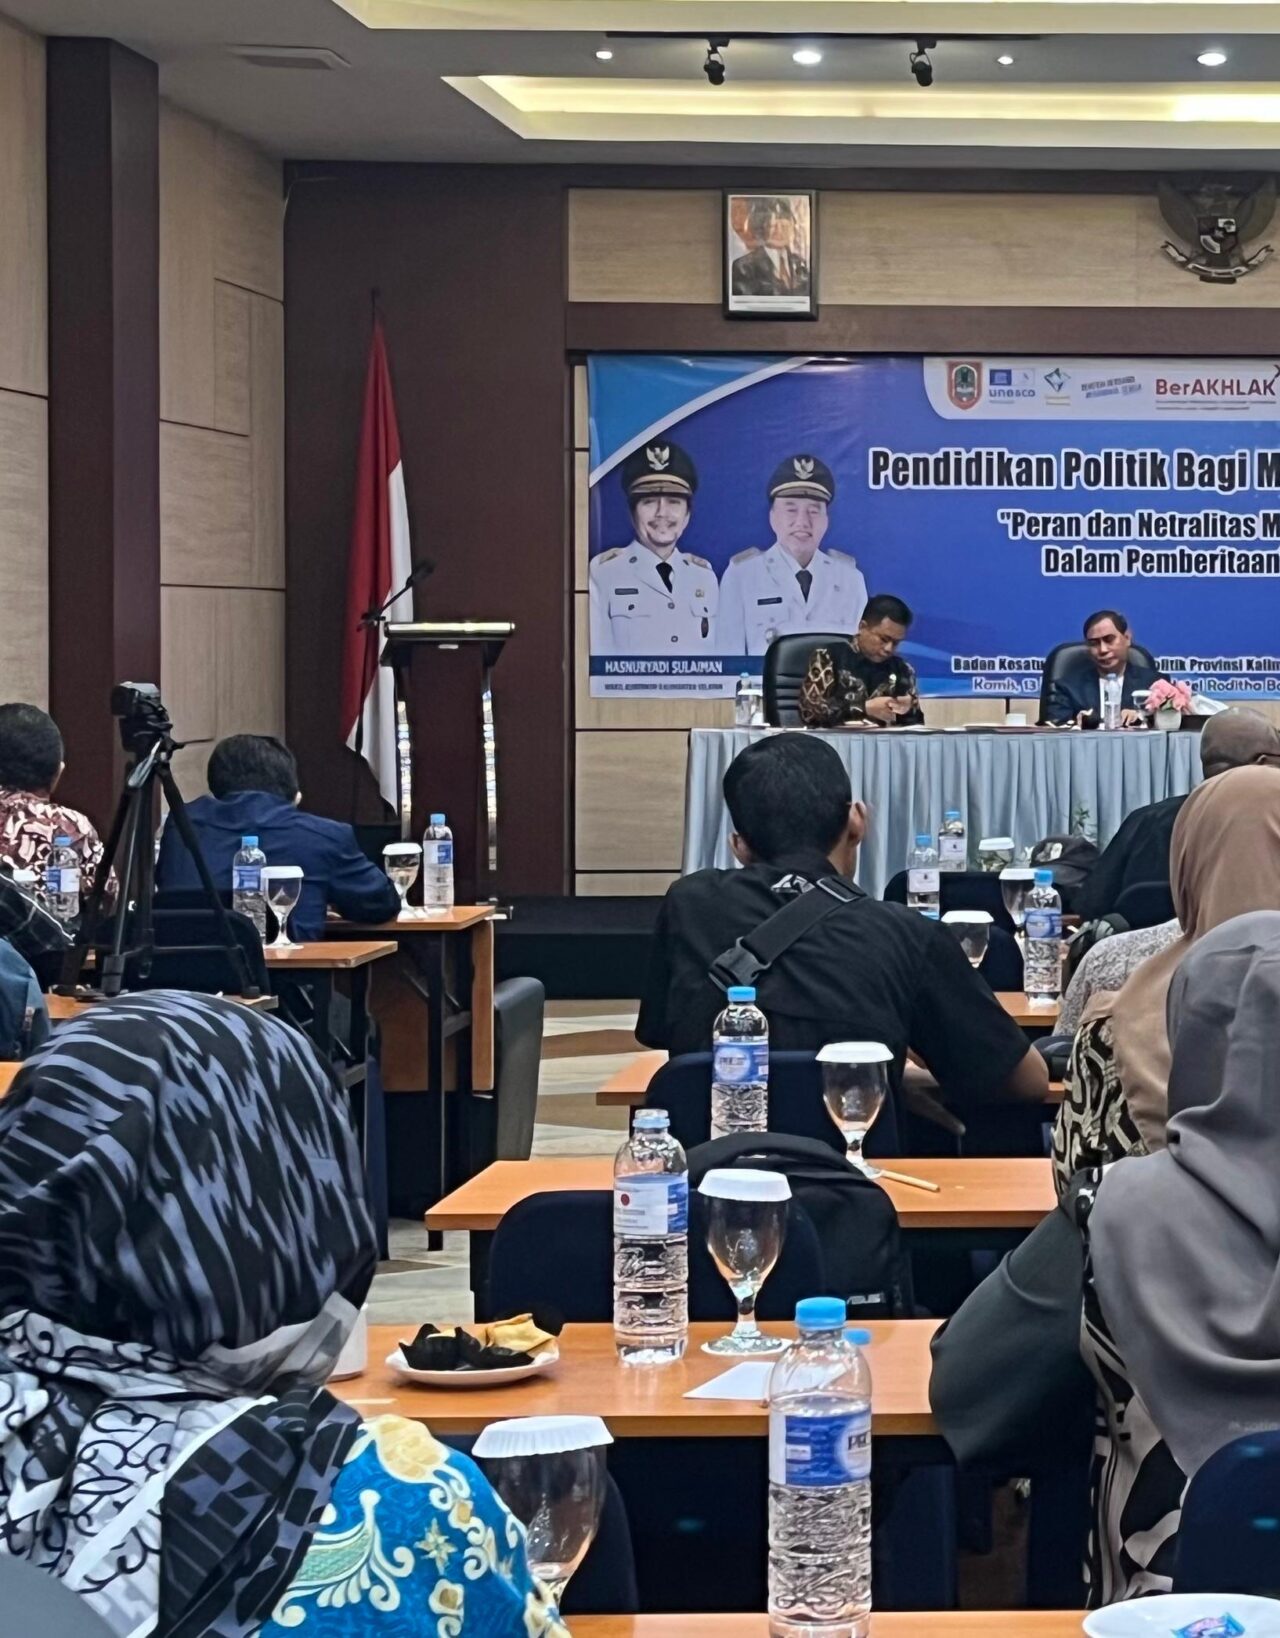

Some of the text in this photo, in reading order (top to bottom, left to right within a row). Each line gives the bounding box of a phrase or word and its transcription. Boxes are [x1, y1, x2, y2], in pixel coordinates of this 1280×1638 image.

[988, 388, 1036, 398] unesco
[1155, 378, 1276, 396] BerAKHLAK
[870, 449, 1055, 488] Pendidikan
[1063, 450, 1168, 488] Politik
[1176, 451, 1248, 491] Bagi
[999, 511, 1082, 538] "Peran
[1087, 511, 1132, 538] dan
[1138, 512, 1257, 539] Netralitas
[1044, 547, 1120, 574] Dalam
[953, 657, 1044, 672] Badan Kesatu
[1154, 658, 1186, 672] olitik
[1189, 658, 1243, 672] Provinsi
